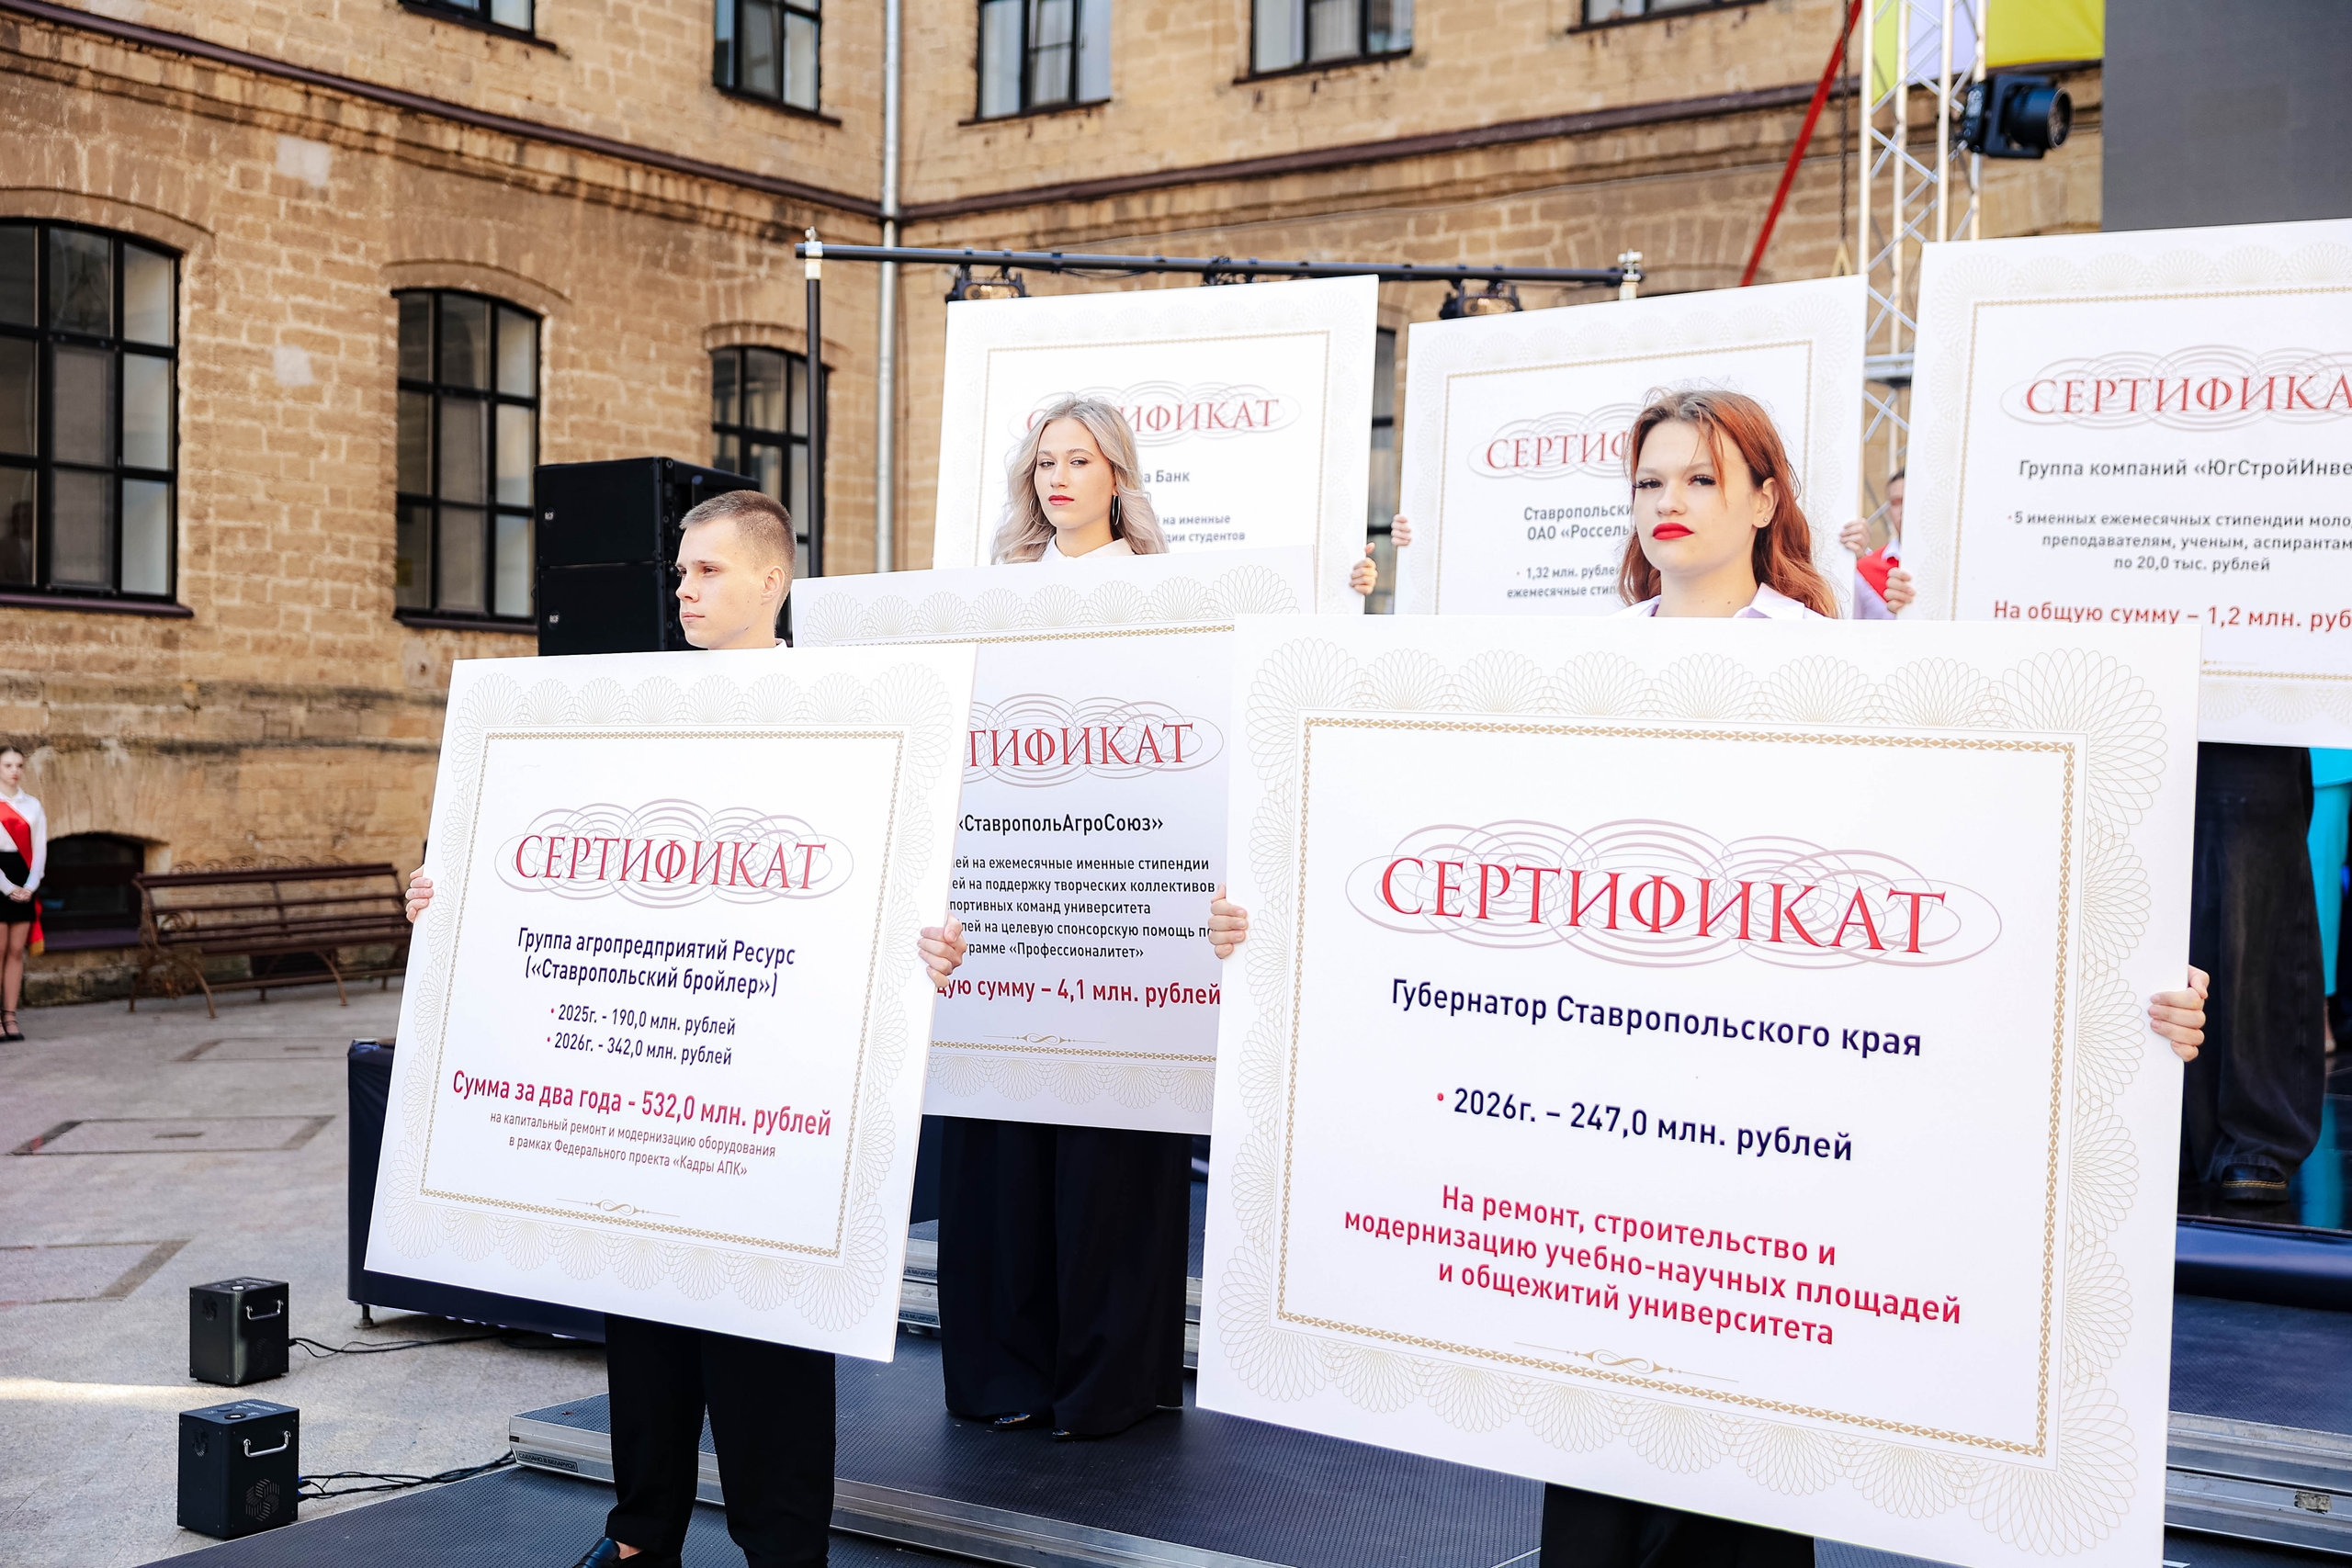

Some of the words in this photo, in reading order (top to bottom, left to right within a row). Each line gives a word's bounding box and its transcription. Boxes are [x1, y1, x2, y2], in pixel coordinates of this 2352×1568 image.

[2026, 374, 2352, 414] СЕРТИФИКА
[1026, 399, 1279, 432] СИФИКАТ
[1486, 431, 1627, 469] СЕРТИФ
[1156, 469, 1191, 483] Банк
[2019, 459, 2084, 479] Группа
[2089, 458, 2188, 476] компаний
[2194, 457, 2352, 479] «ЮгСтройИнве
[1179, 514, 1231, 525] именные
[1524, 504, 1631, 522] Ставропольски
[2015, 511, 2023, 525] 5
[2027, 513, 2097, 525] именных
[2100, 514, 2211, 526] ежемесячных
[2215, 515, 2304, 528] стипендии
[2309, 515, 2351, 528] моло
[1188, 532, 1246, 544] студентов
[1527, 525, 1556, 540] ОАО
[1560, 524, 1630, 538] «Россель
[2041, 536, 2177, 549] преподавателям,
[2180, 537, 2248, 551] ученым,
[1526, 566, 1550, 580] 1,32
[1552, 568, 1578, 578] млн.
[2113, 558, 2133, 570] по
[2136, 555, 2170, 571] 20,0
[2173, 558, 2207, 570] тыс.
[2211, 556, 2270, 574] рублей
[1507, 586, 1588, 598] ежемесячные
[1590, 585, 1617, 595] стип
[1994, 600, 2020, 619] На
[2028, 601, 2104, 624] общую
[2110, 608, 2180, 625] сумму
[2208, 605, 2241, 628] 1,2
[2248, 611, 2301, 627] млн.
[2310, 609, 2352, 633] руб
[969, 722, 1193, 767] ТИФИКАТ
[515, 835, 827, 889] СЕРТИФИКАТ
[972, 858, 986, 869] на
[989, 858, 1073, 870] ежемесячные
[1076, 859, 1135, 870] именные
[1137, 859, 1209, 873] стипендии
[968, 879, 982, 890] на
[985, 880, 1052, 895] поддержку
[1054, 881, 1127, 895] творческих
[1130, 881, 1216, 893] коллективов
[949, 900, 1013, 914] портивных
[1016, 901, 1061, 915] команд
[1063, 902, 1151, 917] университета
[1381, 856, 1946, 954] СЕРТИФИКАТ
[984, 922, 999, 933] на
[1001, 922, 1054, 937] целевую
[1057, 924, 1139, 940] спонсорскую
[1142, 926, 1195, 940] помощь
[517, 927, 572, 953] Группа
[576, 935, 728, 963] агропредприятий
[732, 940, 796, 970] Ресурс
[968, 943, 1006, 957] рамме
[1009, 942, 1144, 959] «Профессионалитет»
[525, 954, 678, 988] («Ставропольский
[683, 967, 778, 999] бройлер»)
[977, 980, 1035, 1003] сумму
[1057, 978, 1084, 1003] 4,1
[1092, 985, 1138, 1002] млн.
[1145, 982, 1221, 1009] рублей
[558, 1003, 597, 1023] 2025г.
[612, 1008, 647, 1030] 190,0
[650, 1015, 681, 1031] млн.
[684, 1015, 736, 1037] рублей
[1392, 977, 1547, 1026] Губернатор
[1556, 995, 1830, 1048] Ставропольского
[1841, 1028, 1921, 1059] края
[554, 1032, 594, 1052] 2026г.
[606, 1036, 643, 1059] 342,0
[646, 1044, 677, 1060] млн.
[680, 1044, 732, 1066] рублей
[453, 1069, 510, 1100] Сумма
[514, 1082, 536, 1102] за
[538, 1085, 574, 1108] два
[579, 1089, 622, 1115] года
[641, 1089, 695, 1123] 532,0
[700, 1103, 746, 1127] млн.
[752, 1105, 831, 1136] рублей
[490, 1112, 502, 1123] на
[503, 1114, 569, 1132] капитальный
[570, 1122, 607, 1136] ремонт
[608, 1127, 616, 1137] и
[616, 1128, 696, 1148] модернизацию
[698, 1134, 776, 1157] оборудования
[1453, 1087, 1536, 1122] 2026г.
[1570, 1101, 1647, 1139] 247,0
[1657, 1118, 1725, 1146] млн.
[1736, 1125, 1852, 1161] рублей
[508, 1136, 515, 1146] в
[516, 1137, 552, 1152] рамках
[554, 1138, 627, 1161] Федерального
[628, 1151, 671, 1167] проекта
[673, 1155, 715, 1175] «Кадры
[716, 1159, 748, 1177] АПК»
[1442, 1184, 1474, 1213] На
[1482, 1196, 1585, 1235] ремонт,
[1594, 1213, 1808, 1262] строительство
[1818, 1245, 1836, 1266] и
[1344, 1211, 1537, 1259] модернизацию
[1545, 1243, 1787, 1299] учебно-научных
[1796, 1280, 1961, 1325] площадей
[1439, 1262, 1453, 1283] и
[1461, 1263, 1619, 1311] общежитий
[1627, 1293, 1833, 1346] университета
